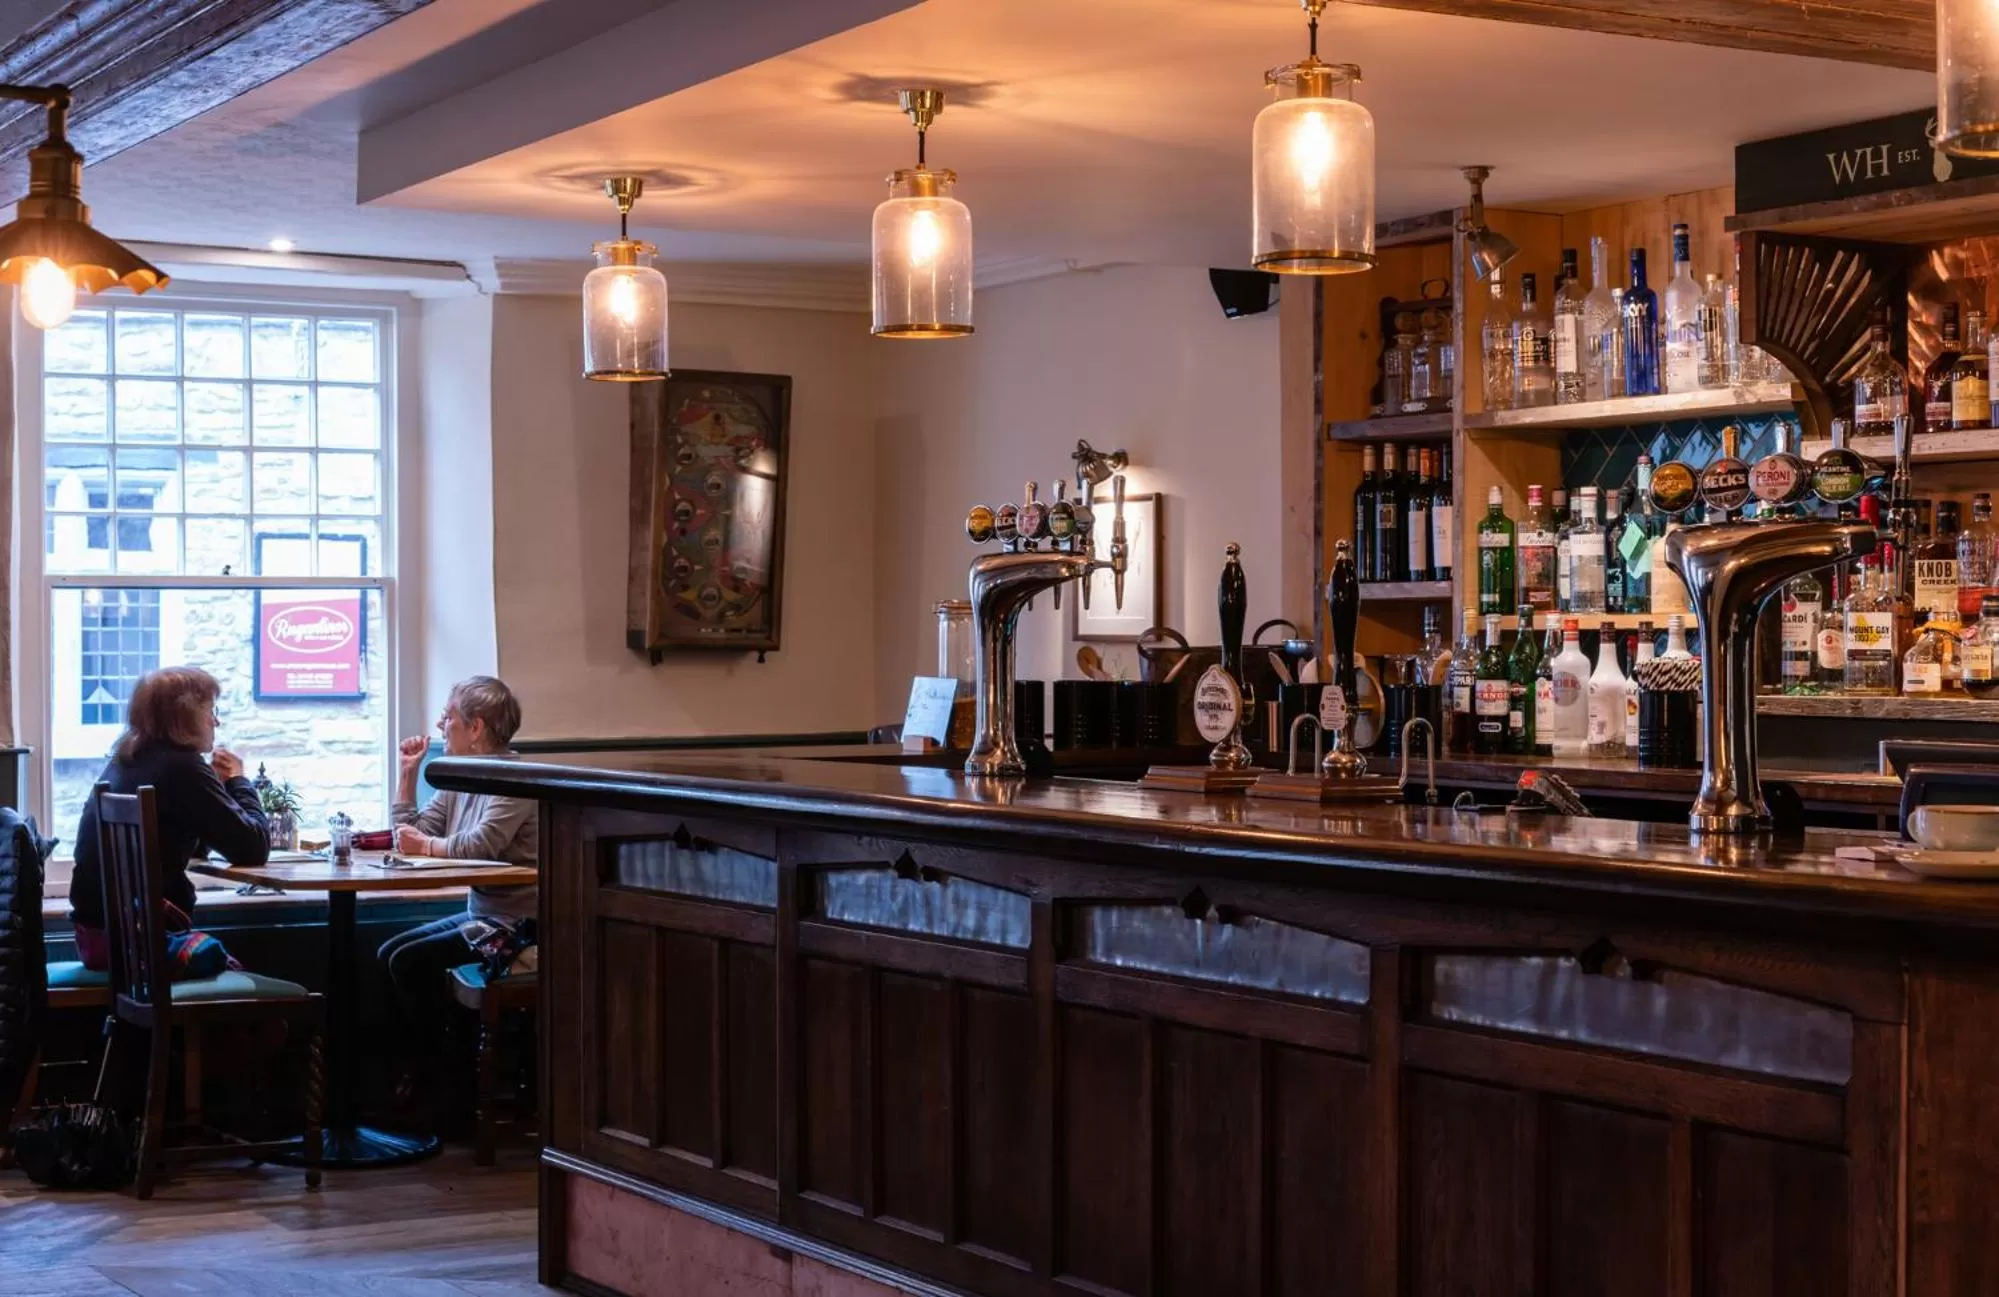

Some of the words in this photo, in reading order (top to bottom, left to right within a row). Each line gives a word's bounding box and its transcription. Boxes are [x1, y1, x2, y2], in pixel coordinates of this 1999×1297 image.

[1826, 143, 1893, 185] WH
[1898, 149, 1921, 164] EST.
[1756, 471, 1791, 482] PERONI
[1918, 561, 1953, 578] KNOB
[1849, 625, 1873, 634] MOUNT
